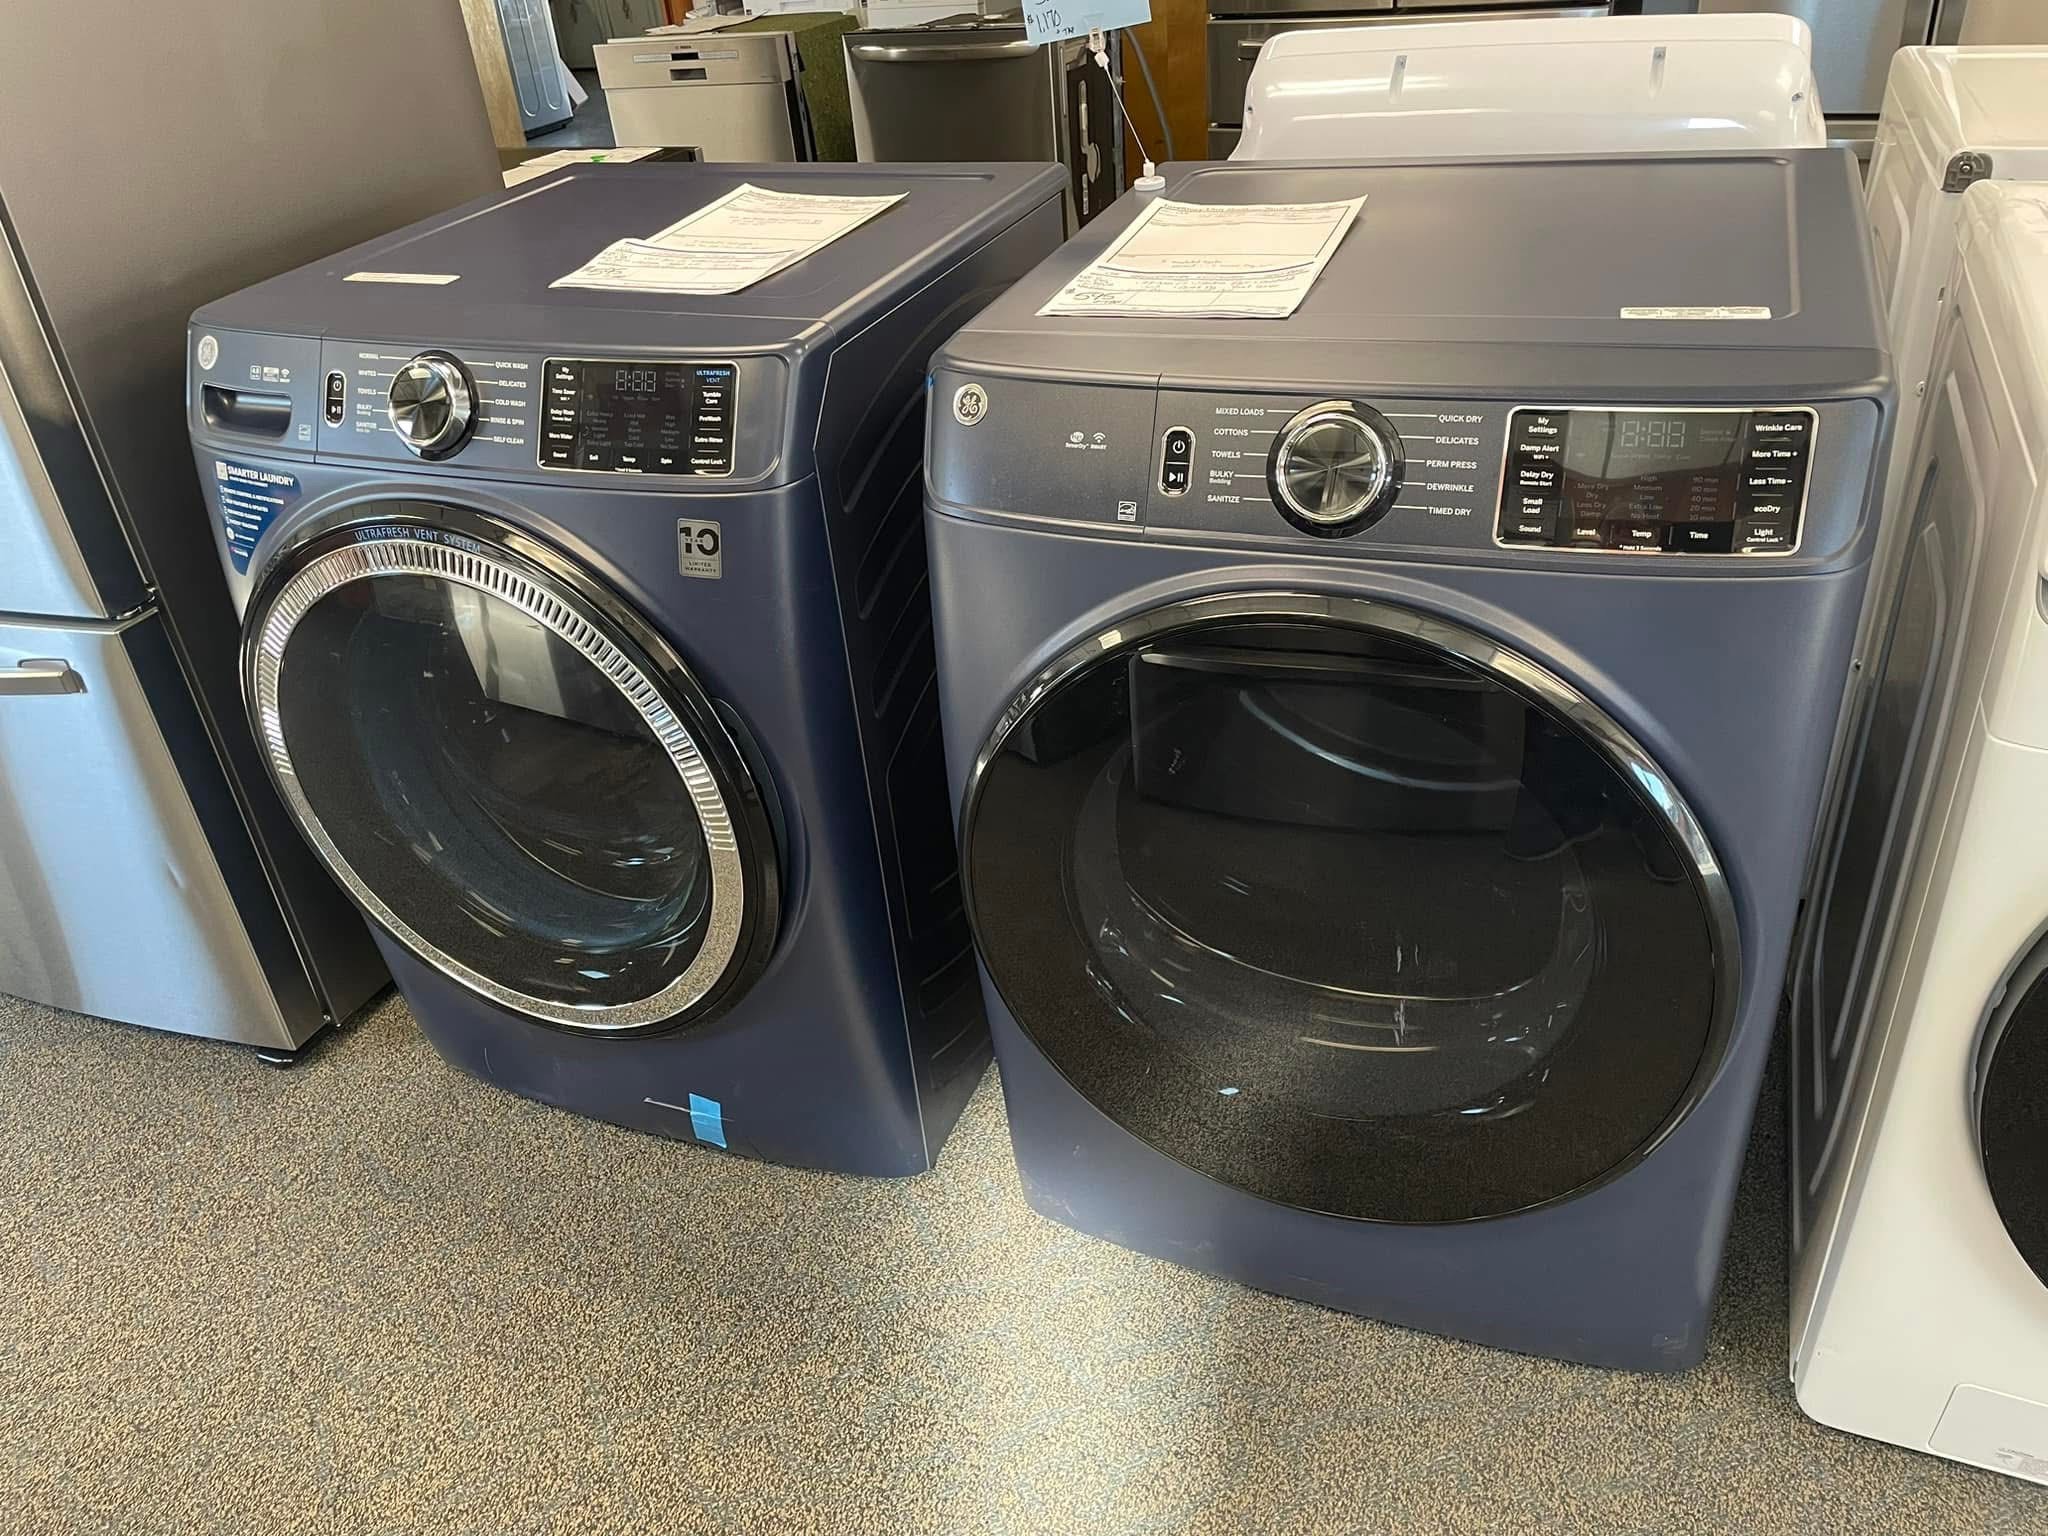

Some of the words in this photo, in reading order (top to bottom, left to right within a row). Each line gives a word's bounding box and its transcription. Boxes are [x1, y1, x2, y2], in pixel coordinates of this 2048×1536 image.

[495, 361, 512, 369] QUICK
[498, 380, 527, 389] DELICATES
[1215, 407, 1239, 415] MIXED
[1240, 408, 1265, 416] LOADS
[1438, 414, 1465, 423] QUICK
[1465, 415, 1484, 423] DRY
[1537, 417, 1549, 426] My
[1213, 428, 1249, 437] COTTONS
[1528, 425, 1558, 435] Settings
[1755, 424, 1783, 432] Wrinkle
[1784, 424, 1803, 432] Care
[1435, 436, 1480, 445] DELICATES
[1520, 444, 1541, 453] Damp
[1541, 444, 1560, 452] Alert
[1211, 450, 1241, 459] TOWELS
[1751, 450, 1772, 458] More
[1772, 450, 1791, 458] Time
[1426, 460, 1449, 468] PERM
[1450, 461, 1478, 469] PRESS
[227, 465, 259, 480] SMARTER
[260, 471, 294, 488] LAUNDRY
[1209, 470, 1234, 478] BULKY
[1520, 470, 1540, 479] Delay
[1540, 470, 1554, 480] Dry
[1767, 477, 1786, 485] Time
[1426, 483, 1475, 493] DEWRINKLE
[1597, 482, 1610, 491] Dry
[1207, 494, 1241, 503] SANITIZE
[1586, 492, 1600, 500] Dry
[1522, 498, 1543, 506] Small
[1576, 501, 1594, 509] Less
[1594, 502, 1607, 510] Dry
[1428, 506, 1454, 515] TIMED
[1454, 507, 1472, 516] DRY
[1522, 506, 1541, 514] Load
[1753, 505, 1781, 514] ecoDry
[1518, 524, 1542, 533] Sound
[1576, 528, 1596, 537] Level
[1754, 528, 1773, 537] Light
[1631, 529, 1652, 538] Temp
[1689, 531, 1709, 539] Time
[354, 527, 410, 541] ULTRAFRESH
[413, 529, 439, 541] VENT
[443, 533, 481, 552] SYSTEM
[680, 526, 719, 556] 10
